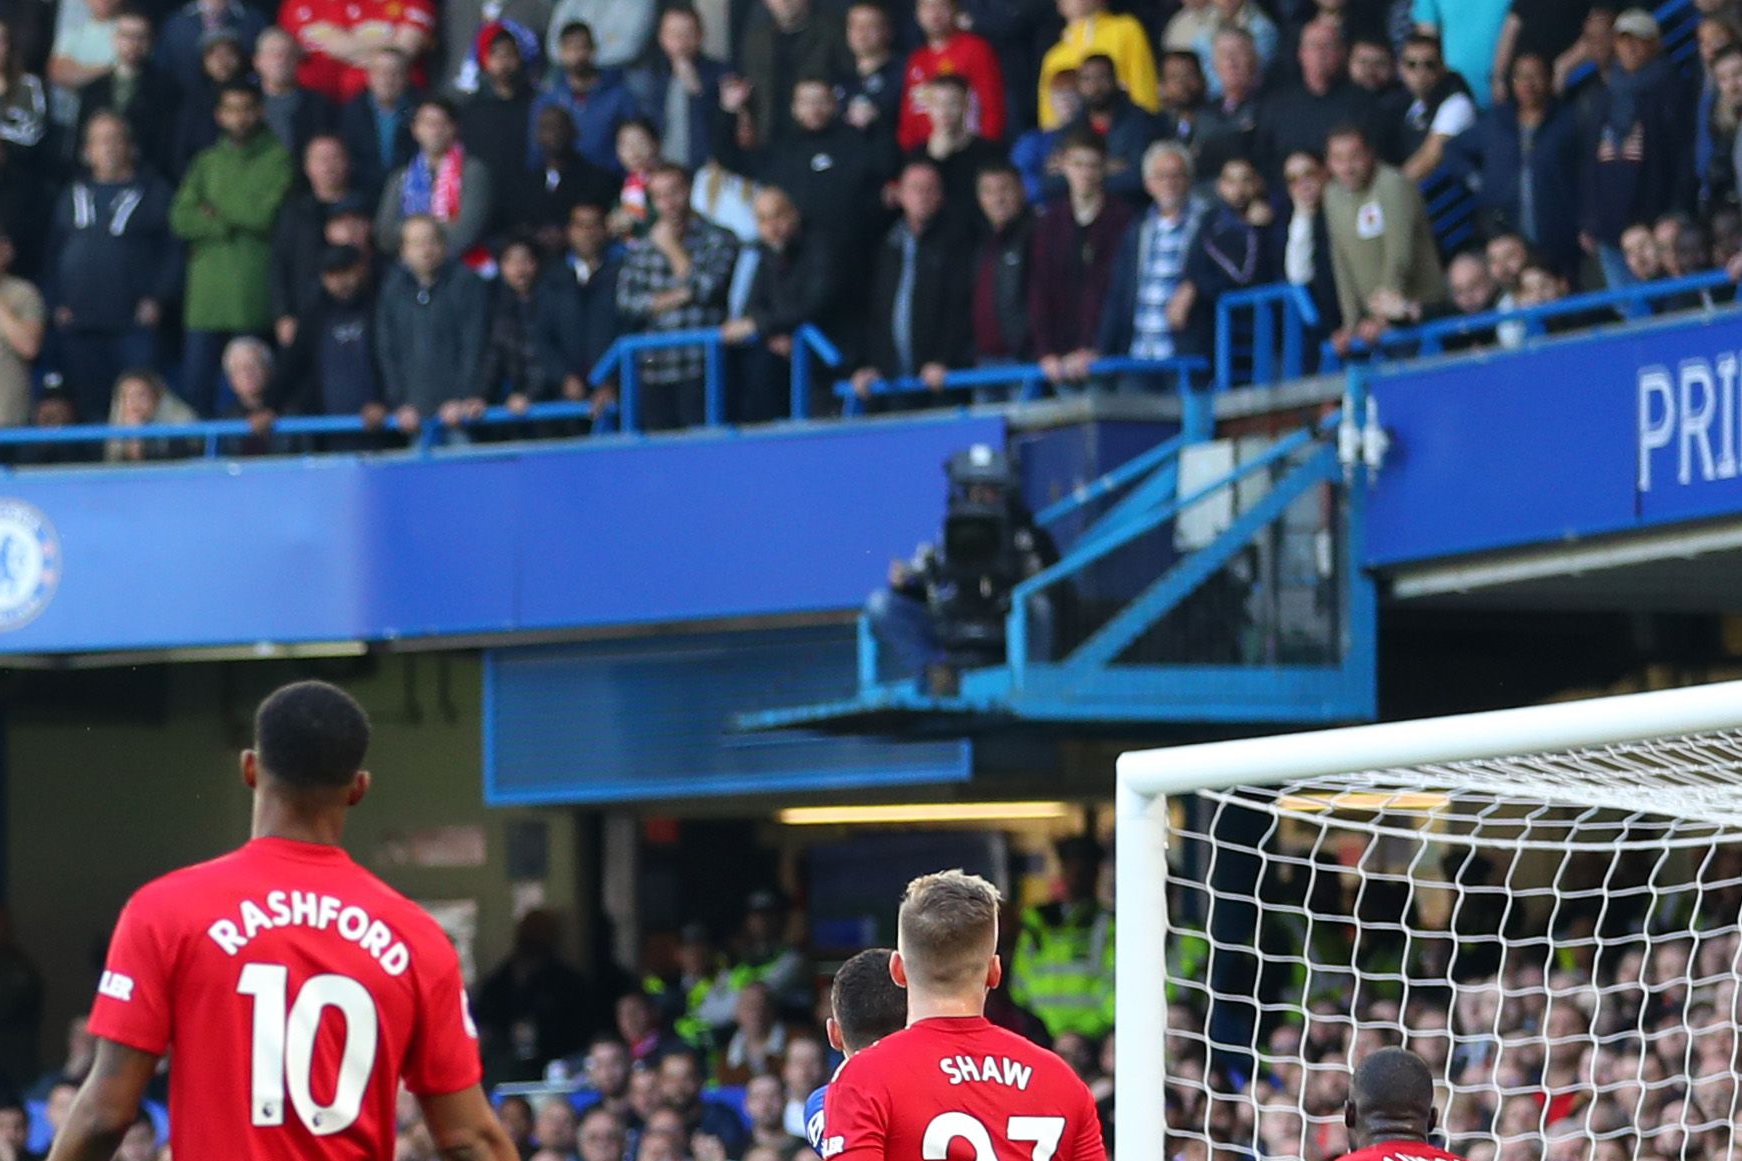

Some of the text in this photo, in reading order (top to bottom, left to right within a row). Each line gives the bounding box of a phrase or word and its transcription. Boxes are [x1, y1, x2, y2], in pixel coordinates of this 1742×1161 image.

[1636, 352, 1742, 492] PRI
[208, 890, 409, 976] RASHFORD
[235, 962, 378, 1136] 10
[939, 1055, 1032, 1091] SHAW
